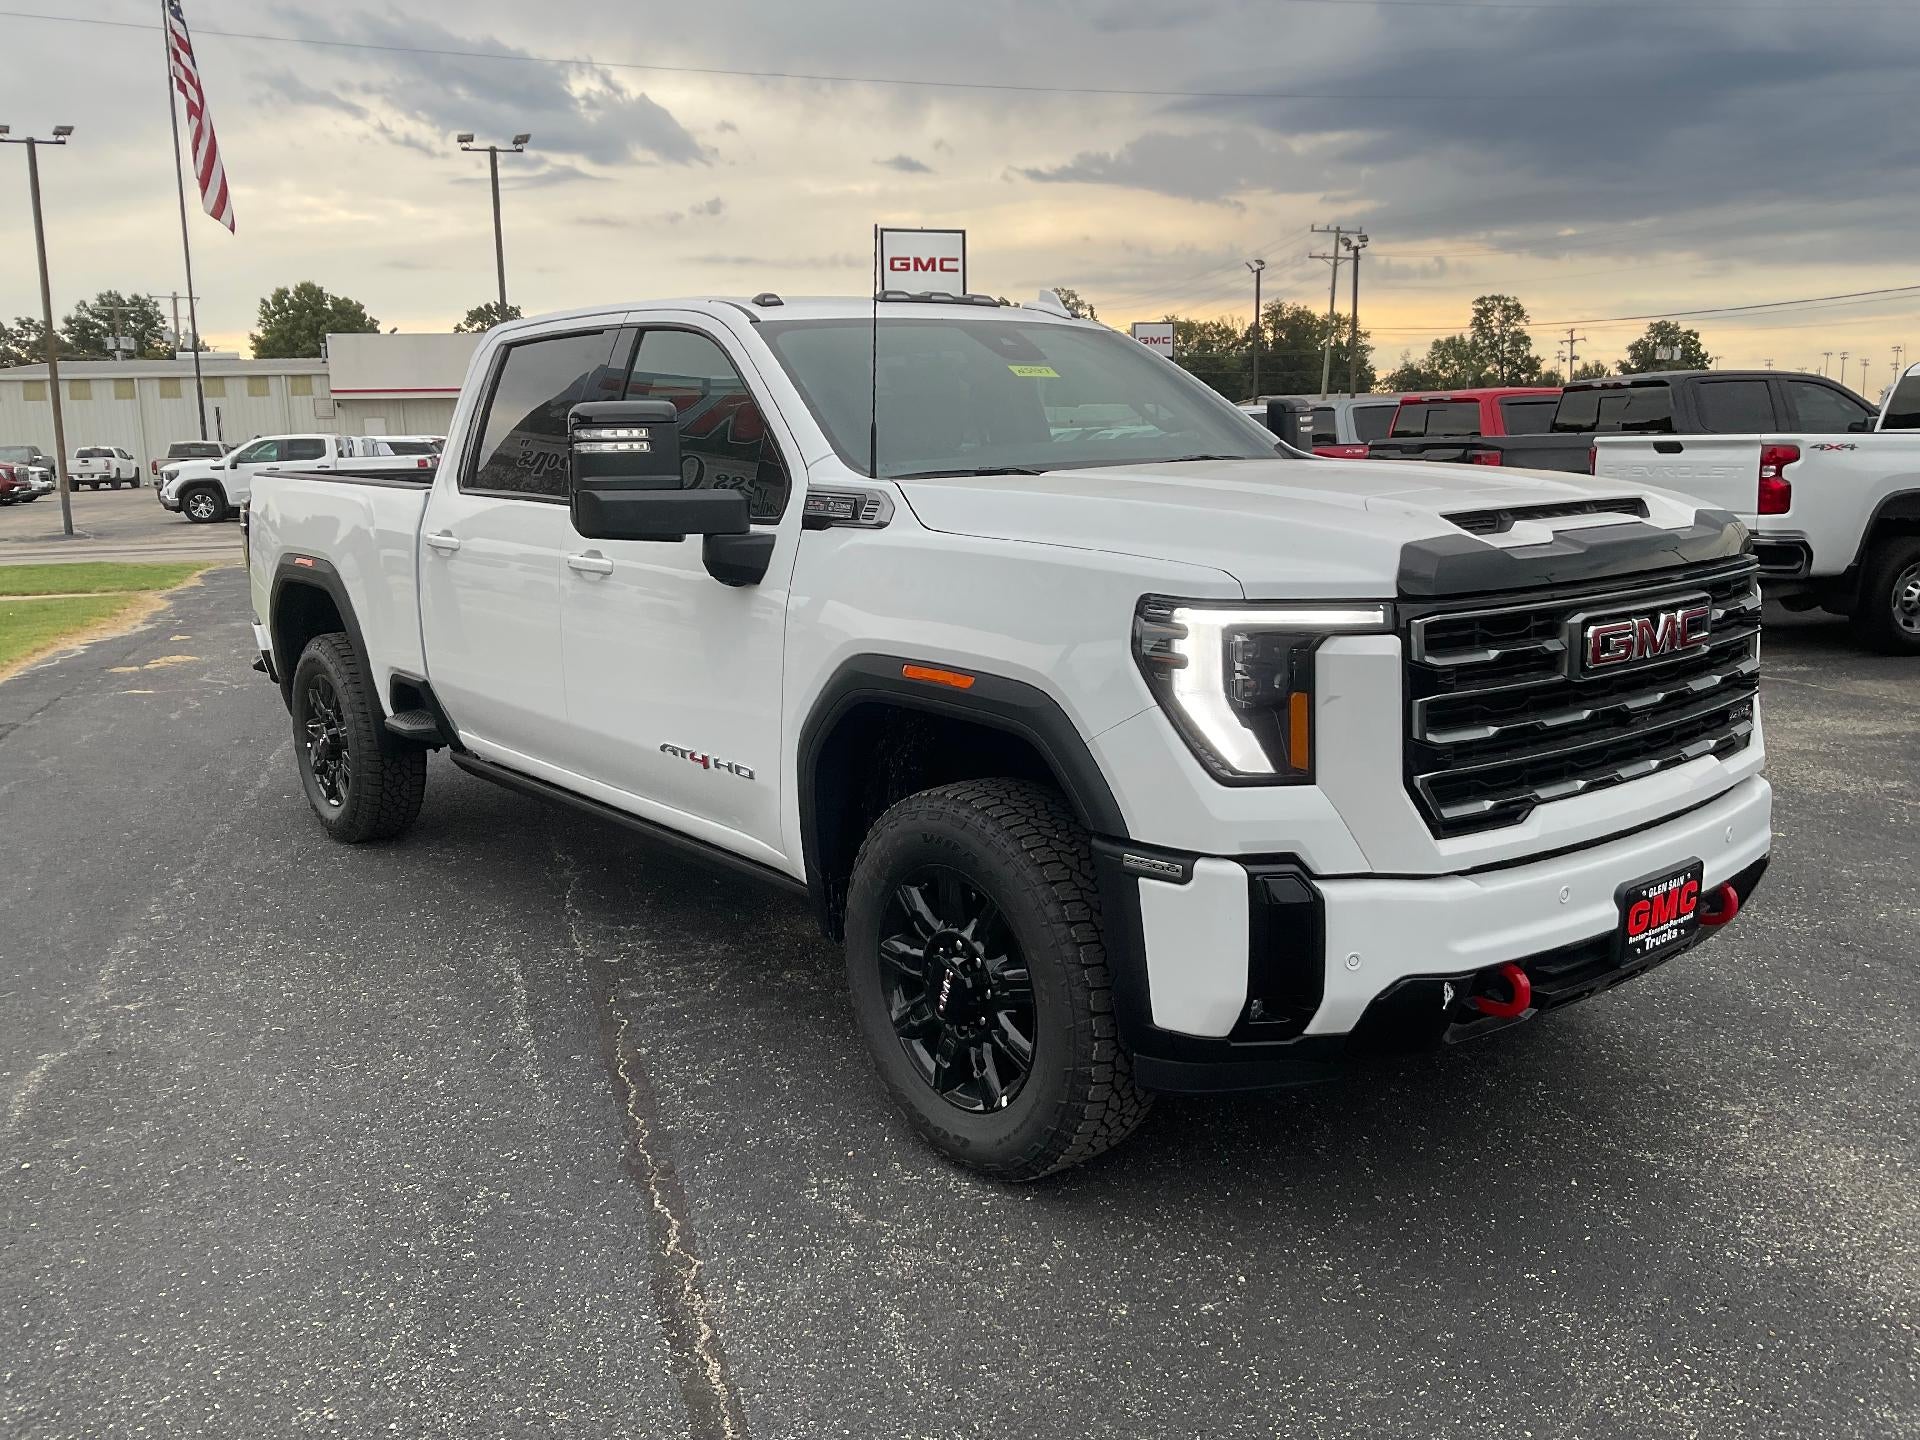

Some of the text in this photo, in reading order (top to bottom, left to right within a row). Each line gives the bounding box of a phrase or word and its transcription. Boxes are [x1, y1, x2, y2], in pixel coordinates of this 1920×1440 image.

[889, 256, 959, 272] GMC
[1138, 336, 1171, 345] GMC
[1603, 464, 1745, 479] CHEVROLET
[1586, 606, 1710, 668] GMC
[713, 757, 756, 780] HD
[1648, 882, 1668, 898] GLEN
[1628, 880, 1698, 935] GMC
[1644, 929, 1678, 951] Trucks
